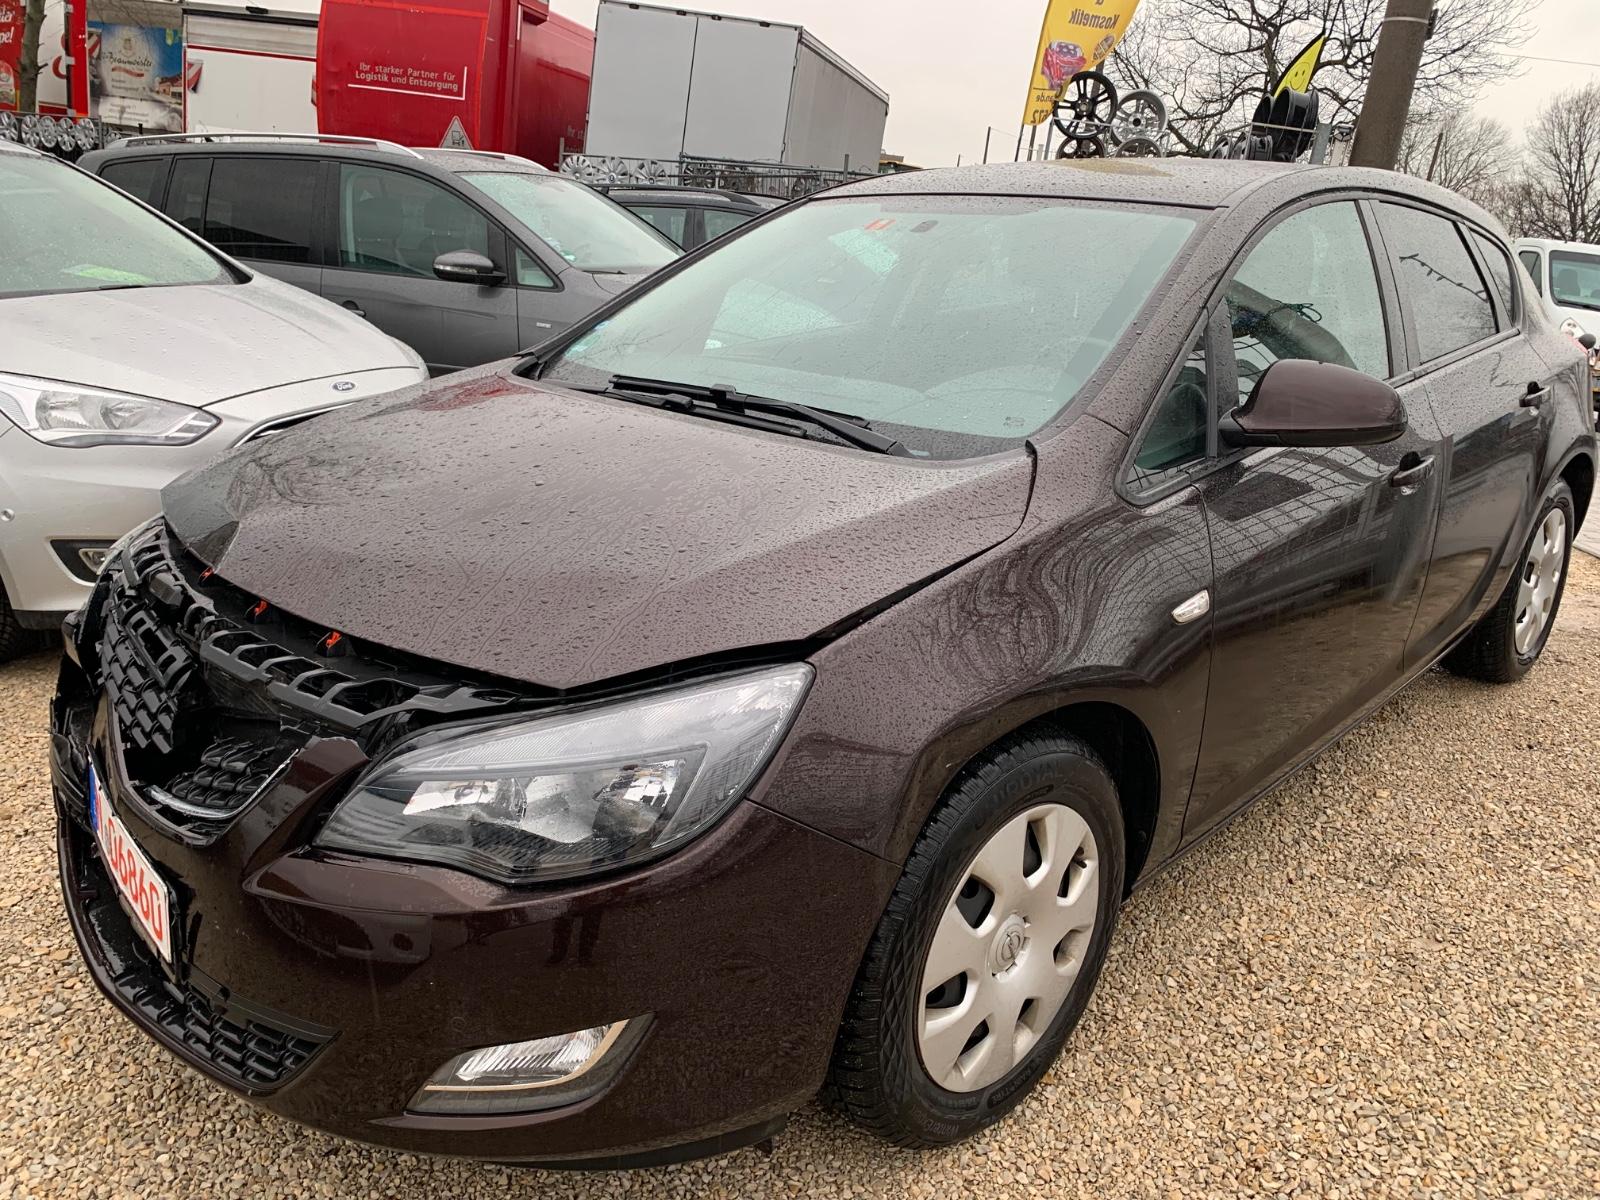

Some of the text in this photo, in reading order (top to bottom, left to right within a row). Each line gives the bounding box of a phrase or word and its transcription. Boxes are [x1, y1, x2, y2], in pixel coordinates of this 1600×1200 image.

[355, 70, 459, 92] Logistik und Entsorgung
[359, 62, 456, 81] Ihr starker Partner für
